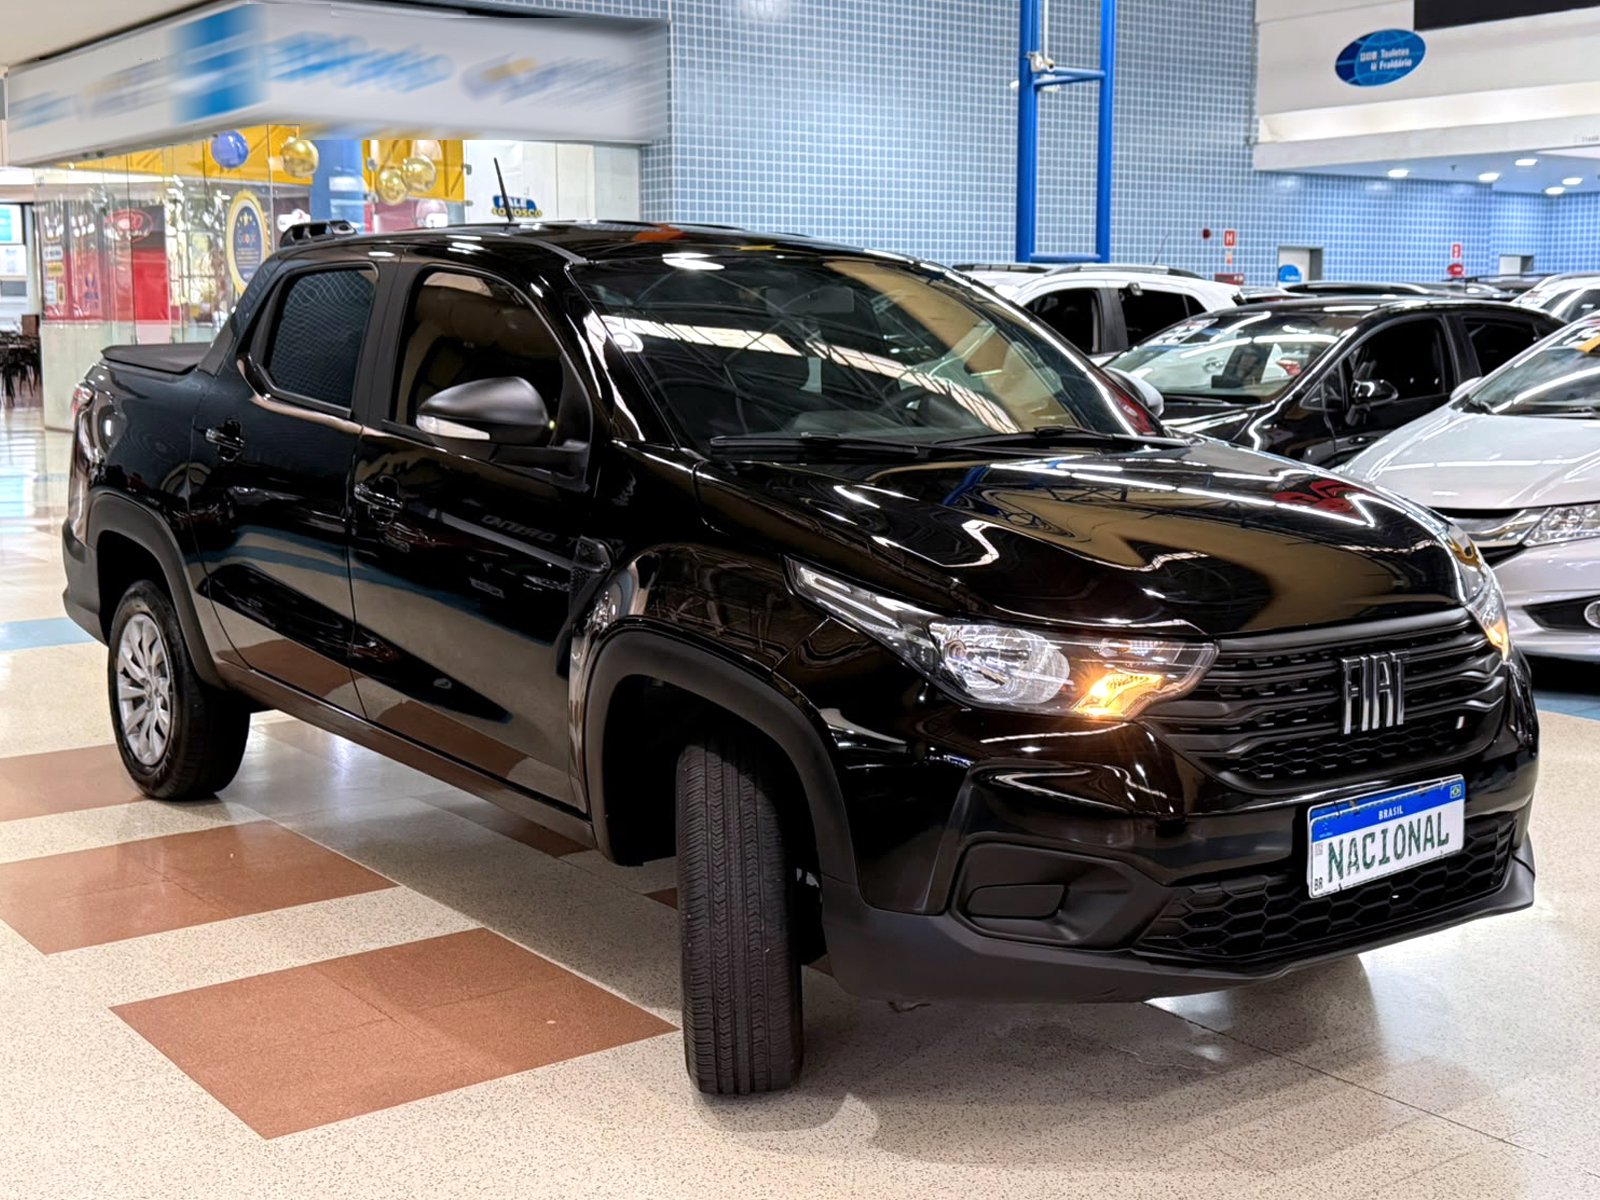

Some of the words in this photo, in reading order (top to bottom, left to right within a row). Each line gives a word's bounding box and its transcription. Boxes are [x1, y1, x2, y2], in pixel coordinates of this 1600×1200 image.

[1341, 650, 1409, 735] FIAT
[1377, 805, 1404, 821] BRASIL
[1327, 811, 1450, 884] NACIONAL
[1313, 876, 1324, 892] BR
